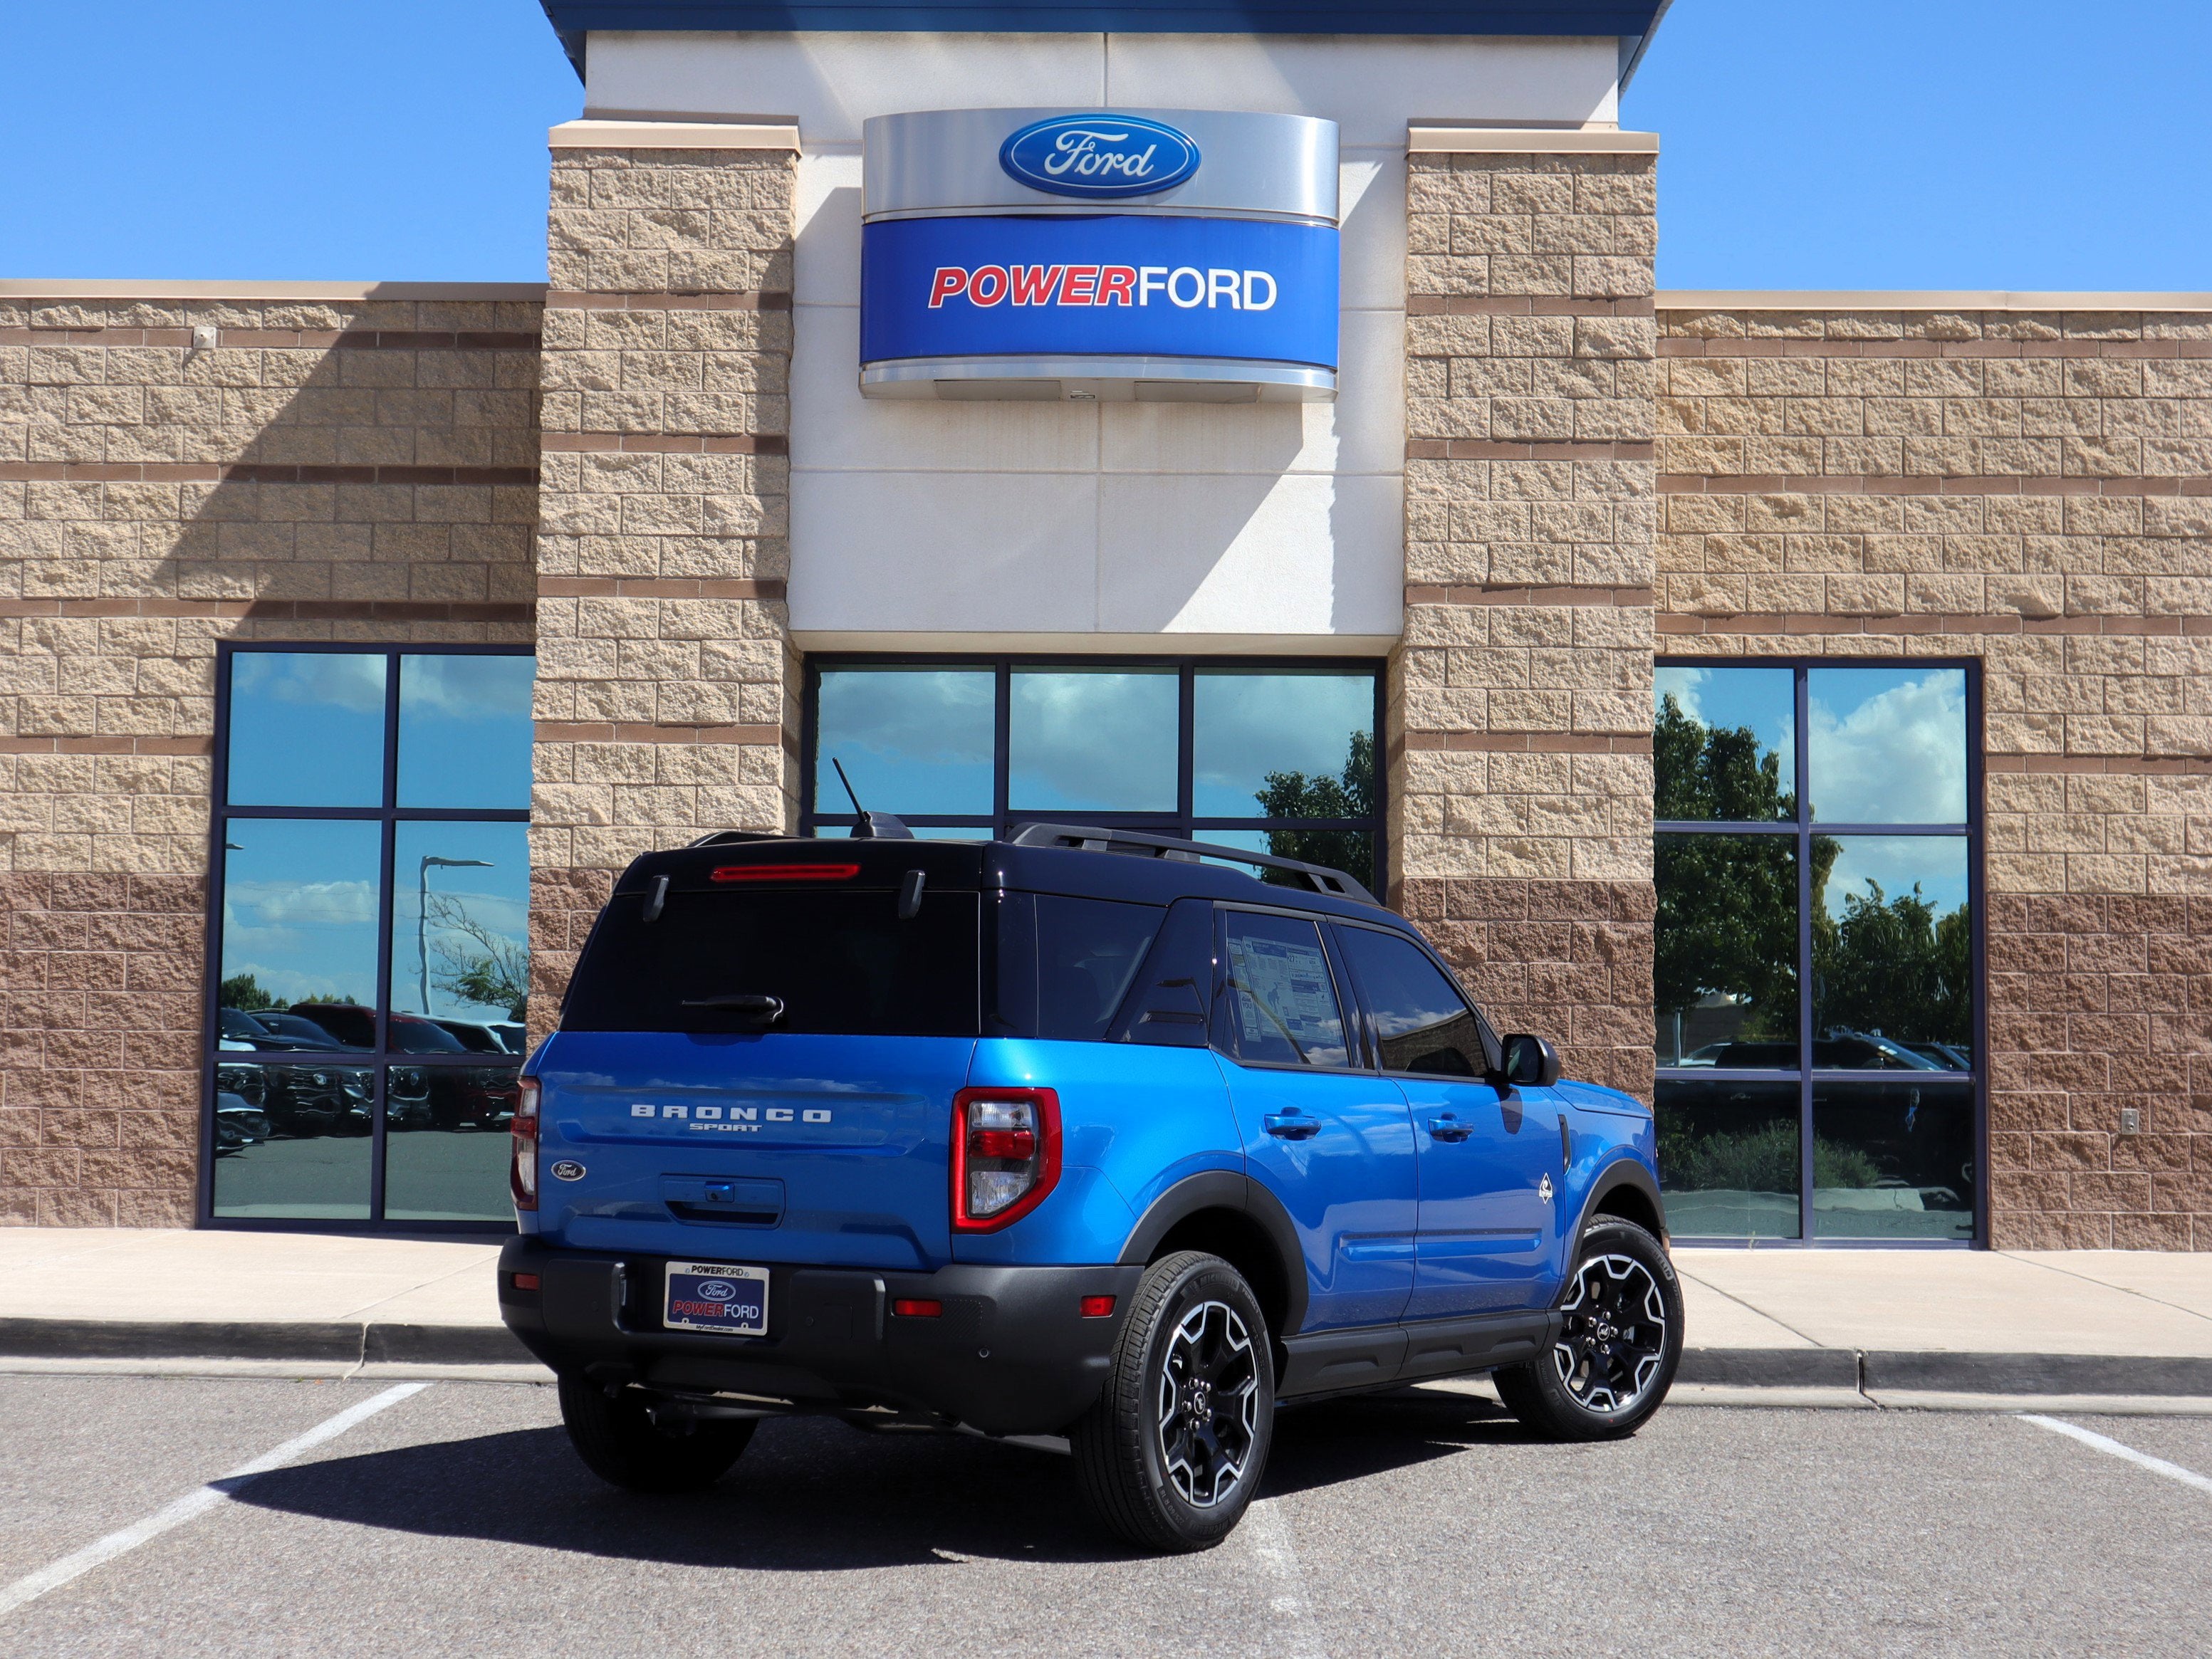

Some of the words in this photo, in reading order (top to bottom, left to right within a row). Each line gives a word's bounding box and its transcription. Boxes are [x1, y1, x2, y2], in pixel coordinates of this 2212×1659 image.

[1044, 130, 1157, 177] Ford
[630, 1104, 833, 1124] BRONCO
[689, 1122, 763, 1133] SPORT
[557, 1163, 578, 1176] Ford
[704, 1284, 729, 1297] Ford
[695, 1324, 734, 1333] MyFordDealer.com
